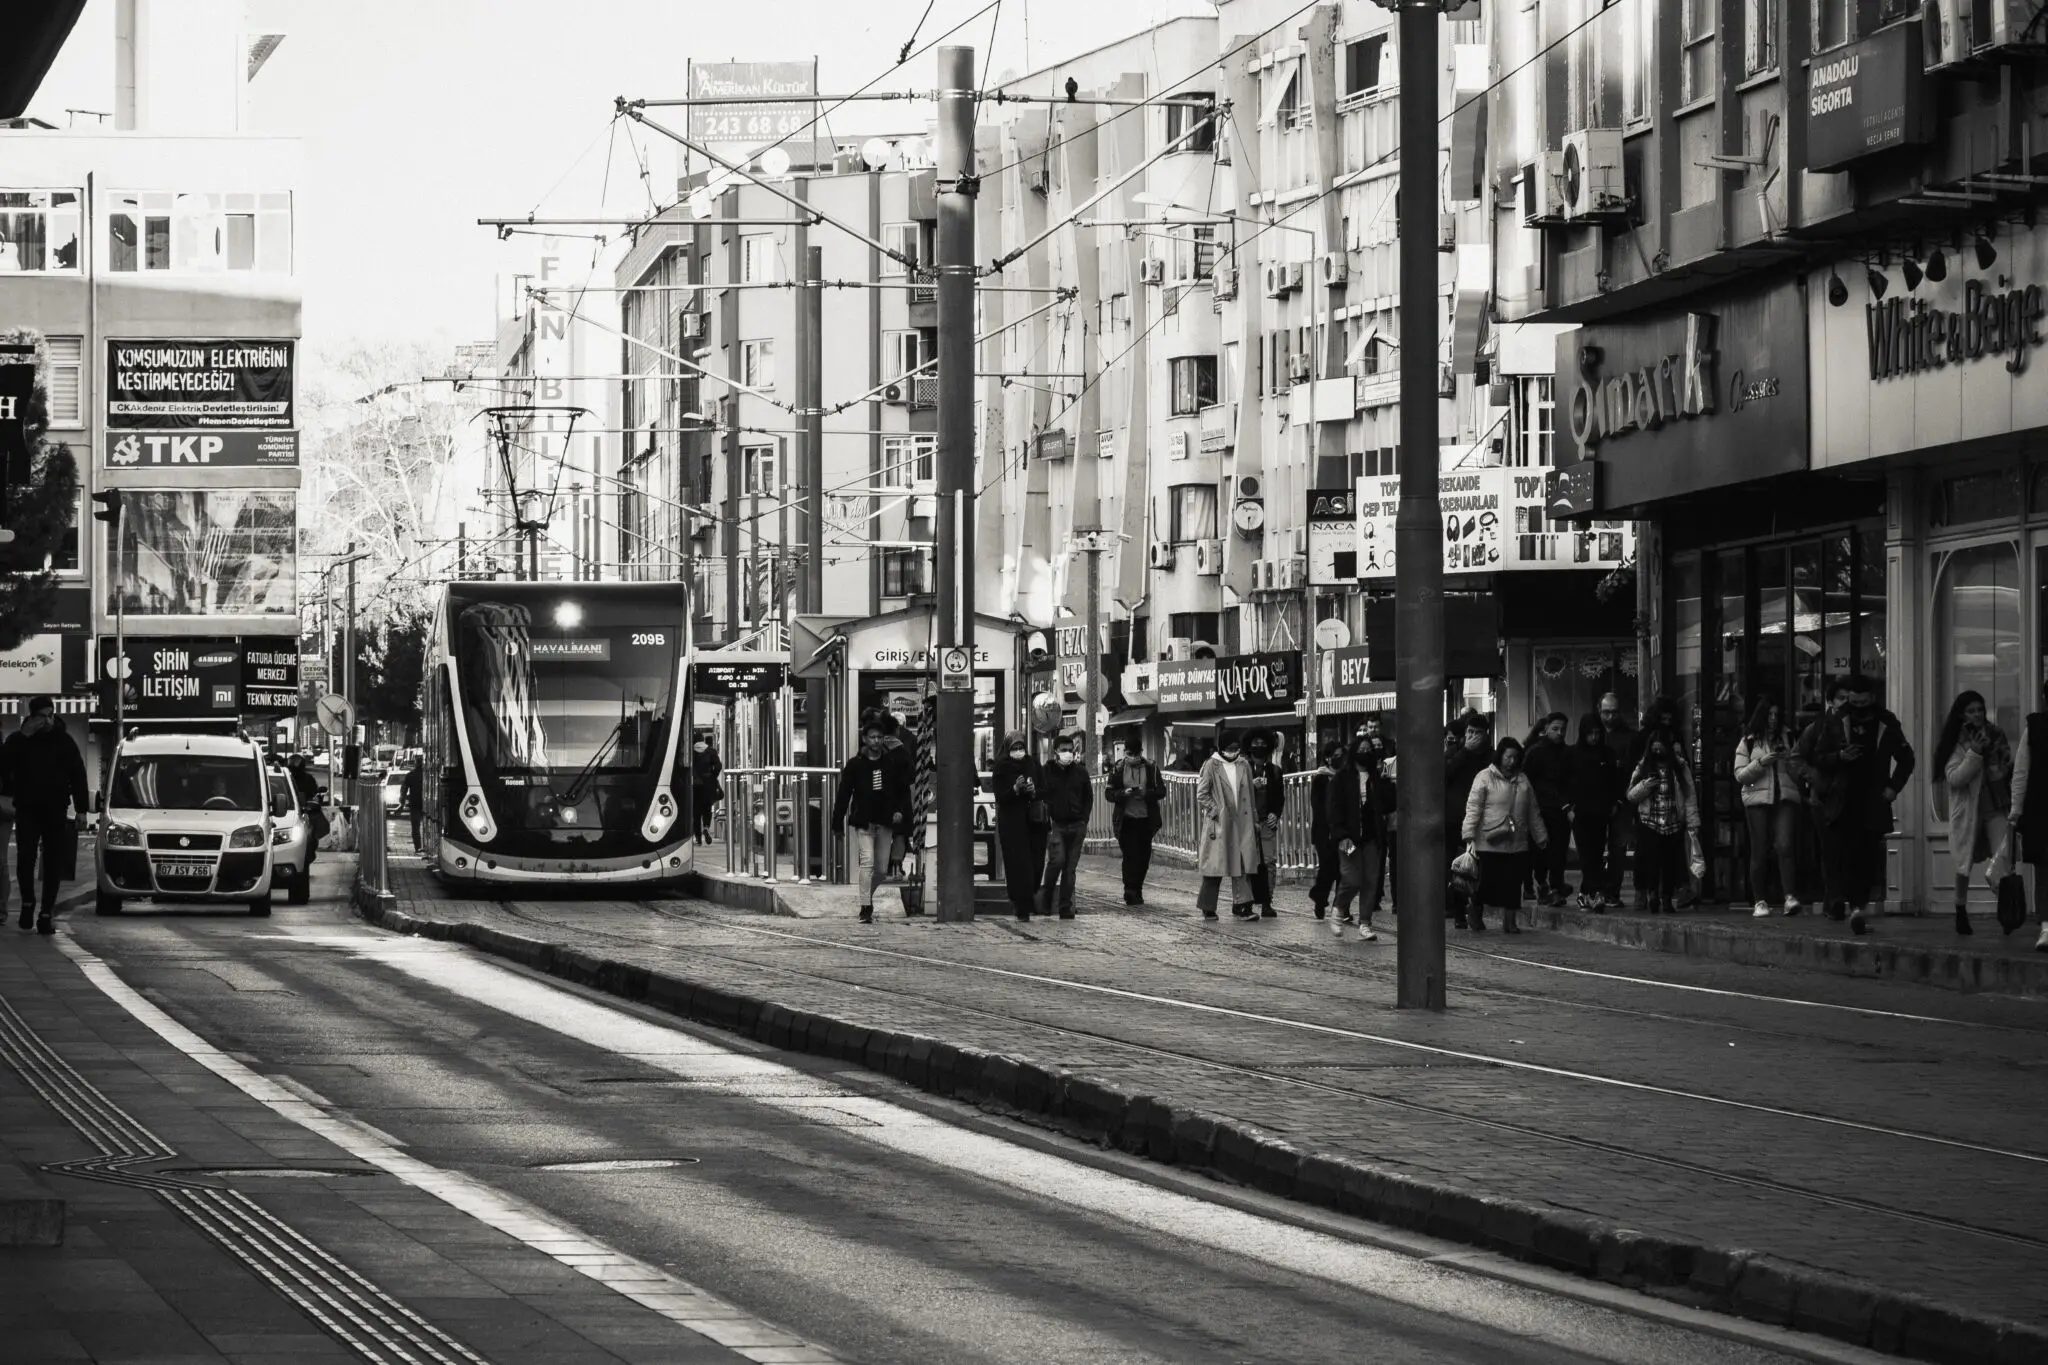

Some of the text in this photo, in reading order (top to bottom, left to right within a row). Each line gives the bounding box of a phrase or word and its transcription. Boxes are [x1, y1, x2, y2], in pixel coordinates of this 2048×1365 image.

[1812, 55, 1859, 88] ANADOLU
[1811, 86, 1853, 117] SİGORTA
[705, 116, 800, 135] 243 68 68
[1866, 295, 1946, 381] White
[1965, 278, 2041, 373] Beige
[118, 347, 288, 369] KOMŞUMUZUN ELEKTRİĞİNİ
[117, 370, 235, 391] KESTİRMEYECEĞİZ!
[144, 436, 223, 463] TKP
[1363, 502, 1380, 517] CEP
[632, 634, 665, 645] 209B
[153, 648, 189, 673] ŞİRİN
[247, 651, 297, 666] FATURA ÖDEME
[257, 667, 286, 681] MERKEZİ
[1158, 668, 1186, 687] PEYNİR
[1217, 657, 1272, 703] KUAFÖR
[143, 675, 200, 700] İLETİŞİM
[247, 691, 298, 707] TEKNİK SERVİS
